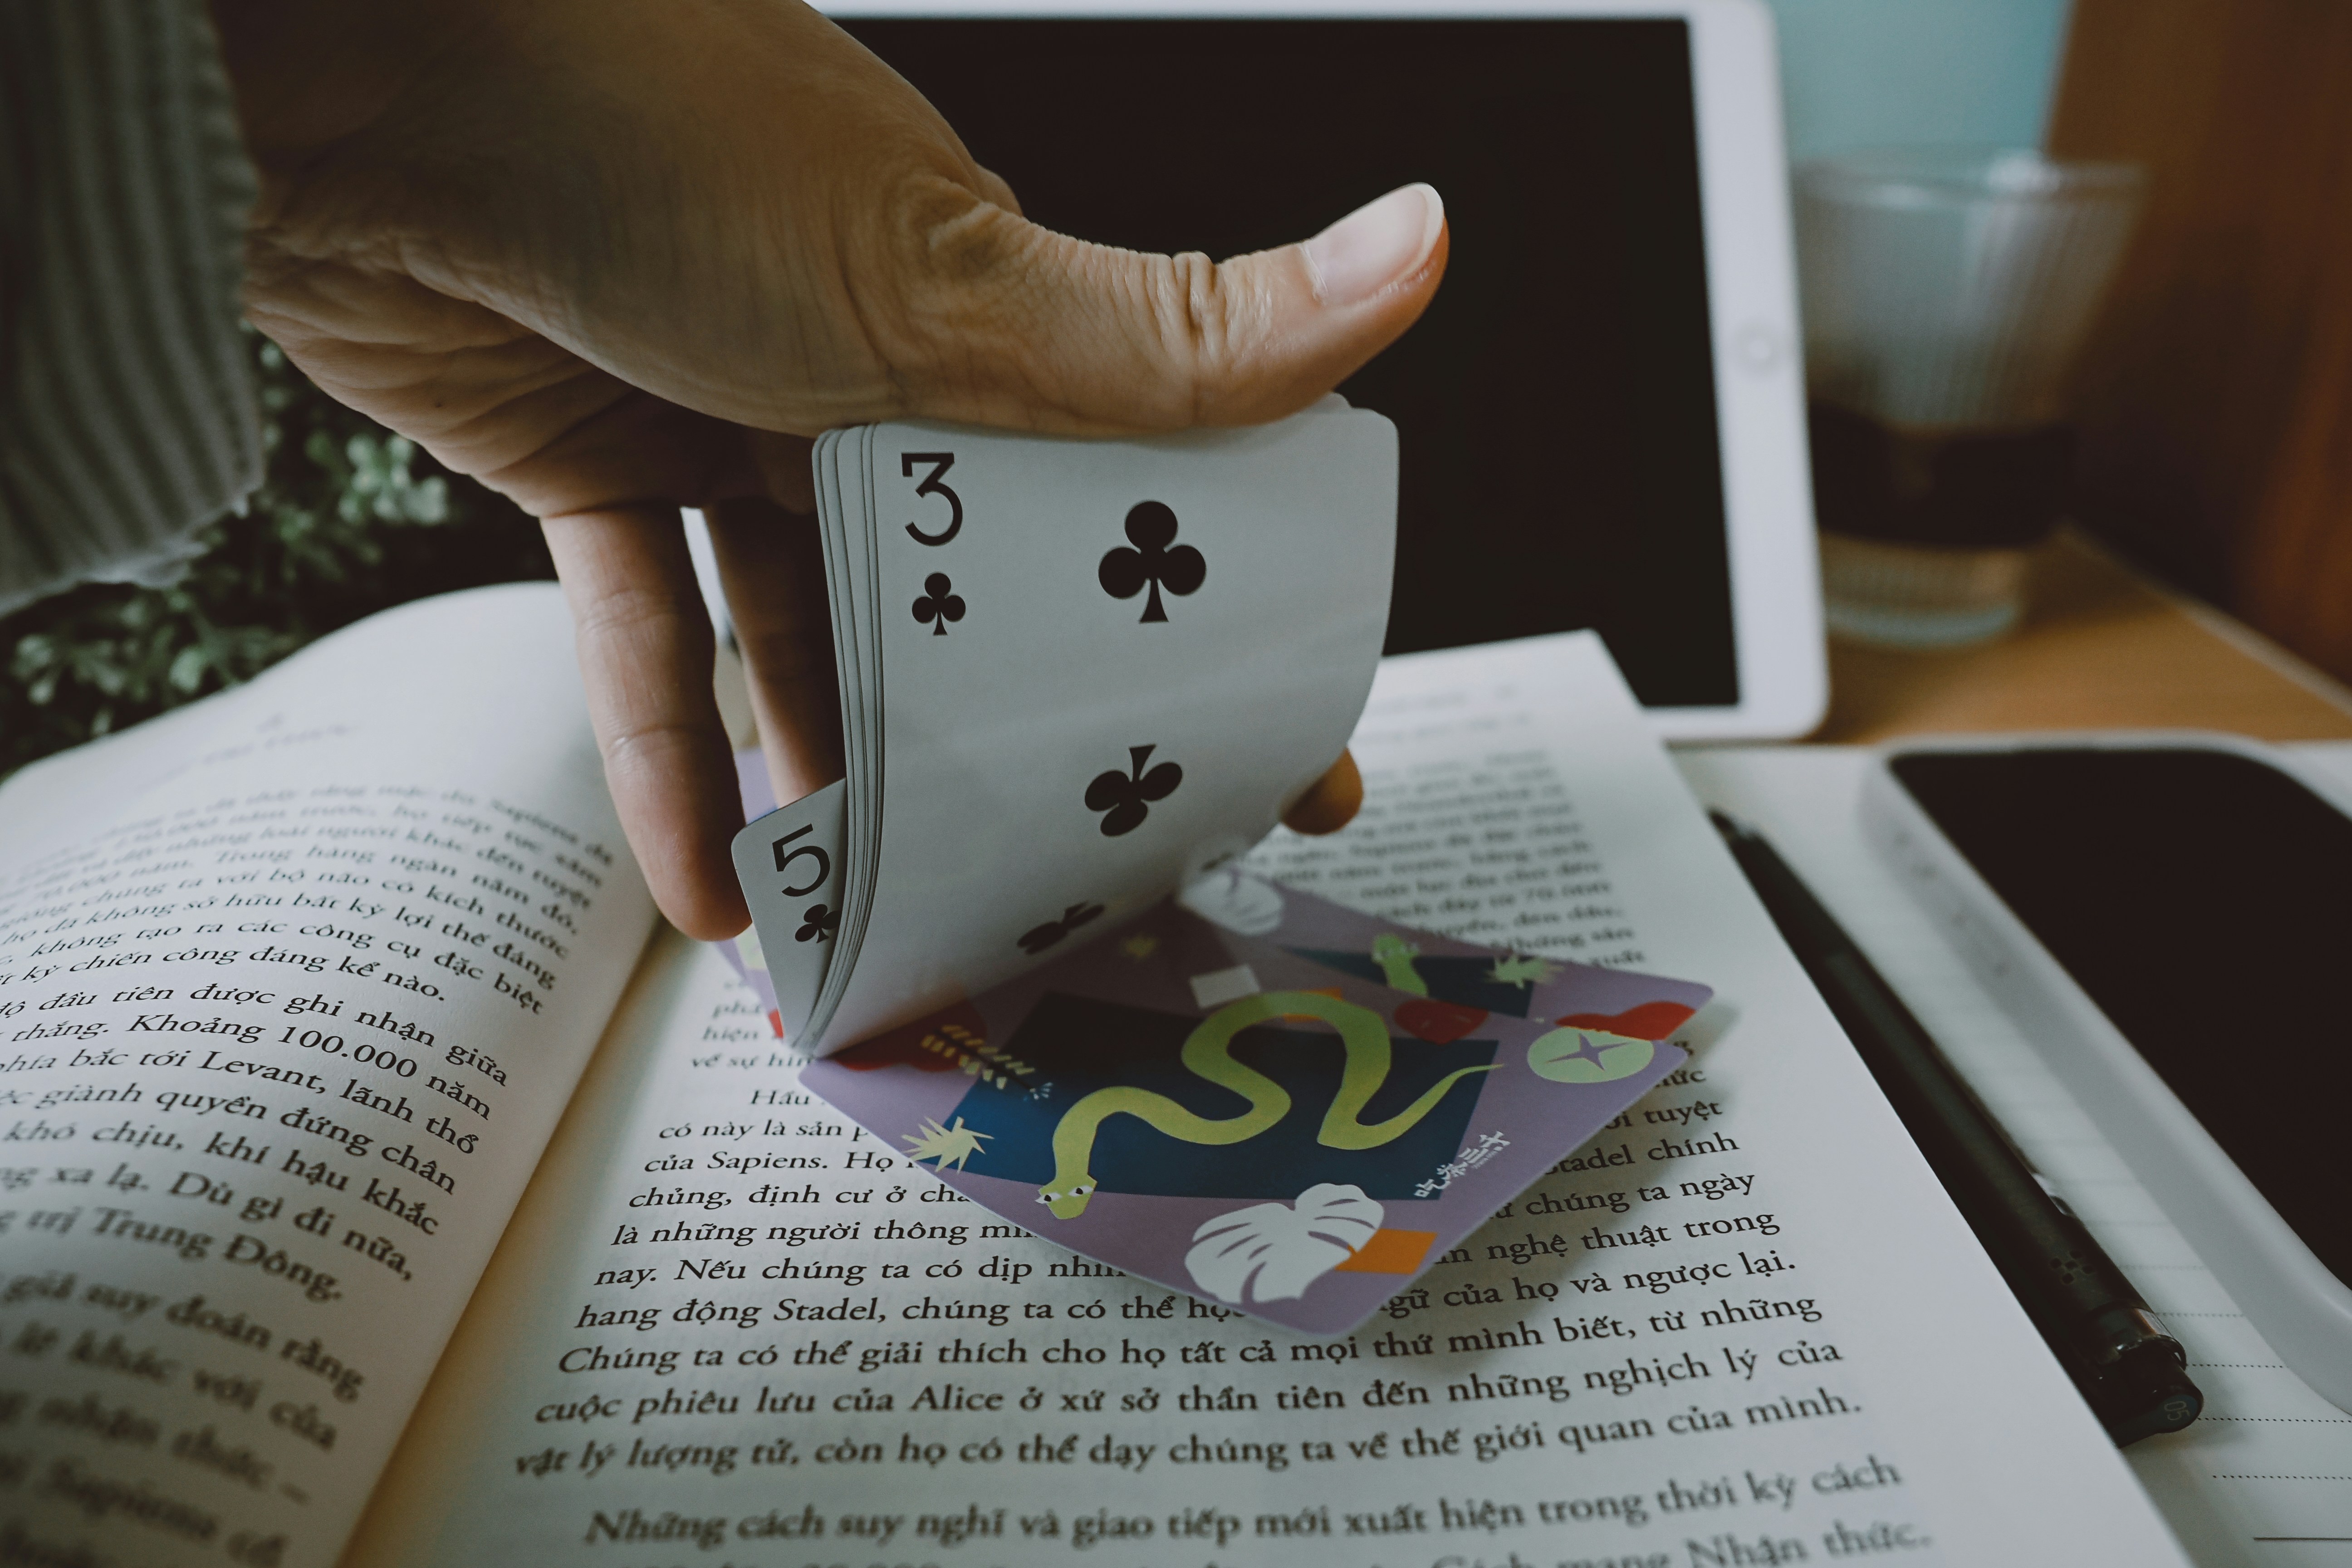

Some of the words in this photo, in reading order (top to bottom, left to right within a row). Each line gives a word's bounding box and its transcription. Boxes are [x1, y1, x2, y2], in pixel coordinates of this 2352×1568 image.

[902, 452, 963, 546] 3
[771, 823, 831, 897] 5
[19, 965, 62, 983] kỳ
[69, 951, 152, 973] chiến
[162, 947, 242, 965] công
[250, 946, 327, 972] đáng
[338, 956, 380, 976] kể
[383, 973, 444, 1001] nào.
[29, 932, 124, 957] không
[135, 926, 181, 941] tạo
[195, 923, 223, 933] ra
[238, 920, 287, 933] các
[299, 924, 376, 949] công
[387, 940, 422, 959] cụ
[434, 952, 483, 979] đặc
[494, 973, 542, 1014] biệt
[225, 892, 282, 907] hữu
[293, 892, 341, 908] bất
[395, 906, 434, 929] lợi
[441, 921, 490, 946] thế
[493, 943, 555, 990] đáng
[12, 1022, 108, 1042] thắng.
[128, 1014, 265, 1043] Khoảng
[279, 1027, 417, 1077] 100.000
[426, 1076, 490, 1120] năm
[39, 992, 97, 1010] đầu
[113, 987, 173, 1002] tiên
[190, 983, 275, 1004] được
[284, 994, 343, 1016] ghi
[355, 1012, 434, 1047] nhận
[446, 1046, 506, 1087] giữa
[69, 1049, 129, 1067] bắc
[139, 1050, 191, 1066] tới
[199, 1051, 325, 1093] Levant,
[340, 1079, 413, 1122] lãnh
[426, 1117, 479, 1154] thổ
[645, 1155, 693, 1172] của
[707, 1152, 827, 1174] Sapiens.
[845, 1152, 893, 1172] Họ
[1643, 1100, 1723, 1126] tuyệt
[659, 1126, 691, 1138] có
[702, 1121, 754, 1141] này
[764, 1119, 785, 1135] là
[796, 1122, 841, 1136] sản
[750, 1088, 809, 1105] Hầu
[35, 1083, 142, 1109] giành
[157, 1093, 267, 1119] quyền
[280, 1107, 373, 1156] đứng
[382, 1145, 455, 1195] chân
[629, 1187, 731, 1210] chủng,
[749, 1184, 819, 1206] định
[836, 1189, 873, 1203] cư
[886, 1186, 906, 1203] ở
[1647, 1132, 1739, 1161] chính
[204, 1132, 270, 1164] khí
[281, 1150, 348, 1191] hậu
[362, 1178, 438, 1235] khắc
[611, 1225, 638, 1245] là
[650, 1221, 757, 1246] những
[767, 1222, 860, 1246] người
[874, 1219, 969, 1245] thông
[1526, 1192, 1631, 1215] chúng
[1637, 1187, 1670, 1201] ta
[1680, 1173, 1754, 1200] ngày
[224, 1235, 342, 1302] Đông.
[575, 1304, 662, 1331] hang
[673, 1298, 762, 1328] động
[774, 1297, 886, 1323] Stadel,
[902, 1296, 1010, 1326] chúng
[1024, 1303, 1054, 1318] ta
[1068, 1299, 1106, 1319] có
[1121, 1295, 1176, 1319] thể
[1443, 1284, 1503, 1307] của
[1511, 1277, 1558, 1302] họ
[1570, 1273, 1611, 1293] và
[1623, 1264, 1731, 1294] ngược
[1738, 1250, 1795, 1277] lại.
[594, 1269, 656, 1289] nay.
[674, 1259, 745, 1279] Nếu
[762, 1258, 867, 1286] chúng
[882, 1264, 910, 1278] ta
[926, 1259, 962, 1278] có
[978, 1256, 1032, 1284] dịp
[1486, 1233, 1568, 1265] nghệ
[1581, 1225, 1671, 1250] thuật
[1684, 1215, 1780, 1238] trong
[559, 1346, 680, 1375] Chúng
[694, 1350, 723, 1366] ta
[738, 1345, 778, 1365] có
[794, 1340, 853, 1365] thể
[858, 1342, 922, 1372] giải
[939, 1338, 1027, 1363] thích
[1042, 1338, 1106, 1363] cho
[1122, 1338, 1166, 1368] họ
[1181, 1341, 1225, 1363] tất
[1240, 1340, 1276, 1362] cả
[1291, 1336, 1359, 1364] mọi
[1372, 1331, 1433, 1357] thứ
[1448, 1321, 1544, 1352] mình
[1553, 1316, 1636, 1342] biết,
[1649, 1311, 1686, 1332] từ
[1701, 1299, 1822, 1326] những
[535, 1395, 621, 1423] cuộc
[632, 1388, 739, 1425] phiêu
[756, 1386, 815, 1413] lưu
[833, 1388, 893, 1412] của
[911, 1384, 1004, 1411] Alice
[1019, 1387, 1044, 1410] ở
[1061, 1390, 1105, 1411] xứ
[1121, 1387, 1160, 1411] sở
[1179, 1385, 1258, 1411] thần
[1277, 1385, 1345, 1410] tiên
[1362, 1379, 1430, 1407] đến
[1448, 1373, 1570, 1402] những
[1584, 1352, 1710, 1396] nghịch
[1723, 1348, 1756, 1380] lý
[1778, 1341, 1842, 1366] của
[627, 1438, 738, 1476] lượng
[814, 1437, 883, 1464] còn
[898, 1433, 947, 1467] họ
[960, 1437, 1003, 1463] có
[1018, 1434, 1078, 1463] thể
[1089, 1434, 1156, 1472] dạy
[1169, 1434, 1289, 1471] chúng
[1302, 1442, 1335, 1461] ta
[1348, 1432, 1387, 1459] về
[1402, 1427, 1460, 1457] thế
[1474, 1422, 1544, 1462] giới
[1558, 1420, 1654, 1454] quan
[1667, 1406, 1732, 1434] của
[1746, 1387, 1861, 1425] mình.
[736, 1504, 824, 1540] cách
[1538, 1496, 1649, 1526] trong
[1812, 1455, 1901, 1493] cách
